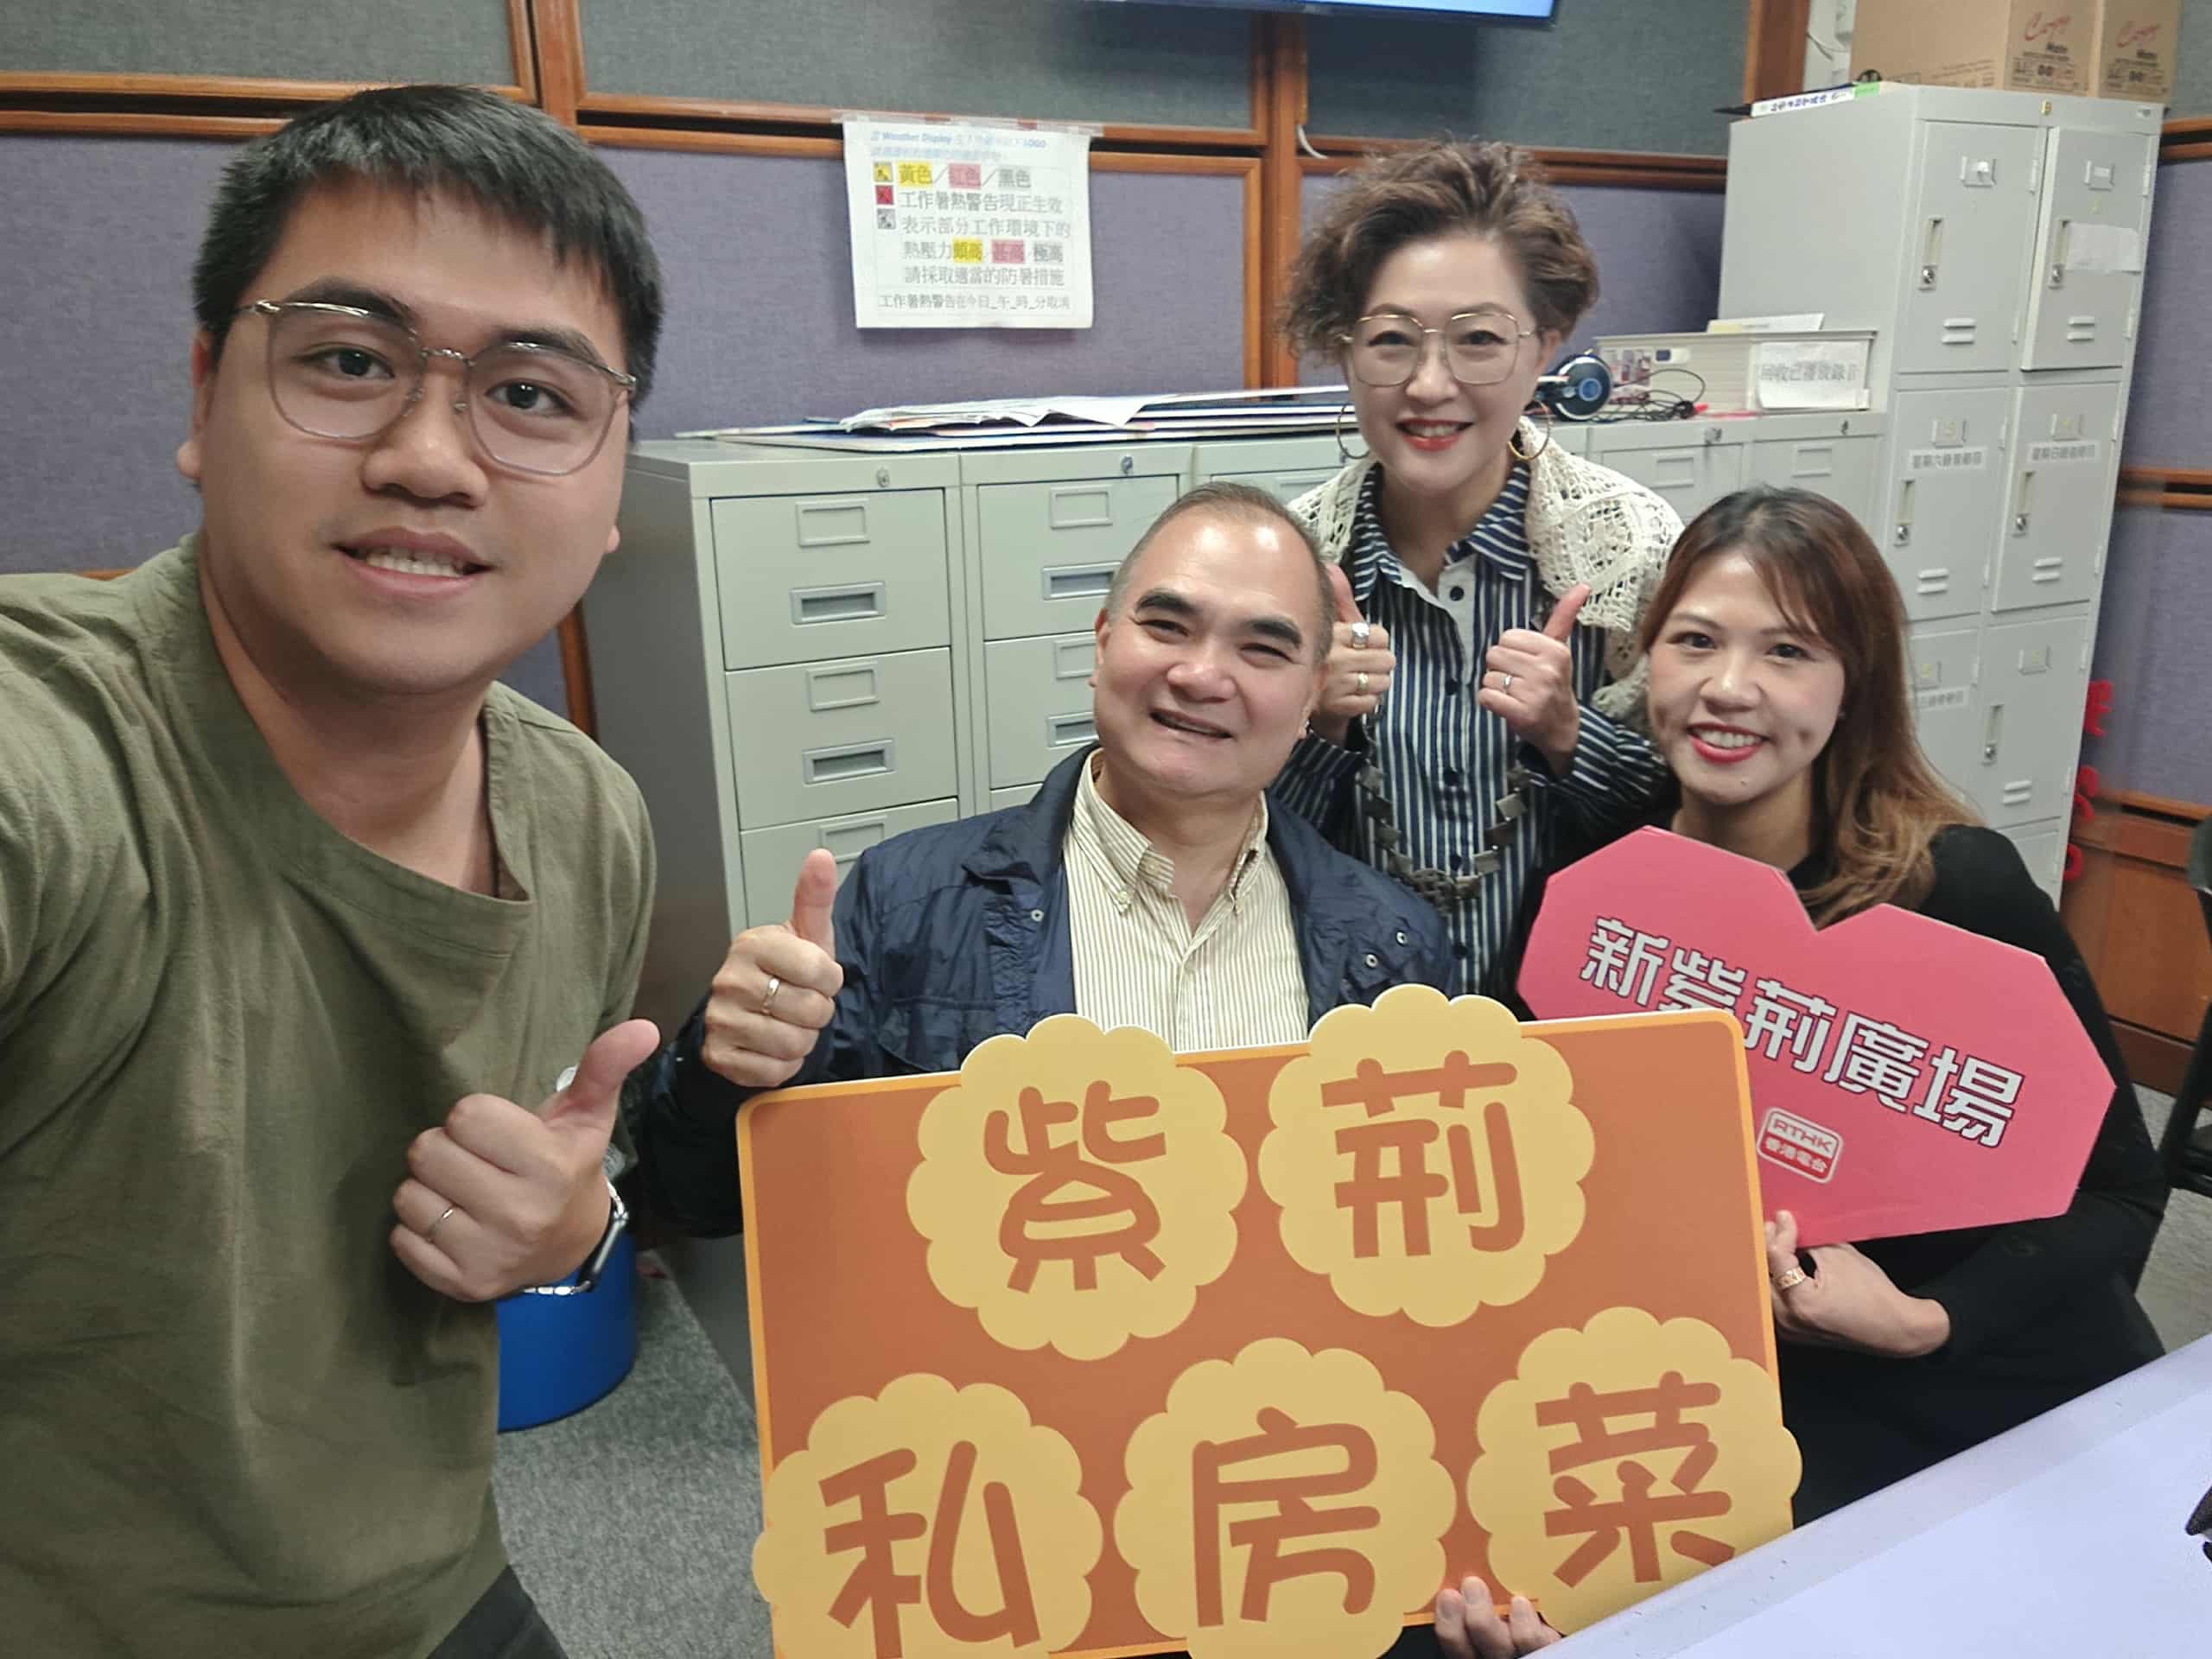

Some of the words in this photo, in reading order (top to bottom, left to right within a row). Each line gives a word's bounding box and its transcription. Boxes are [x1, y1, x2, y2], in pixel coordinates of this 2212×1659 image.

[900, 192, 1063, 213] 工作暑熱警告現正生效
[902, 216, 1071, 238] 表示部分工作環境下的
[905, 266, 1065, 286] 請採取適當的防暑措施
[1580, 917, 2024, 1147] 新紫荊廣場
[1774, 1118, 1833, 1153] RTHK
[983, 1051, 1524, 1293] 紫荊
[818, 1372, 1735, 1659] 私房菜
